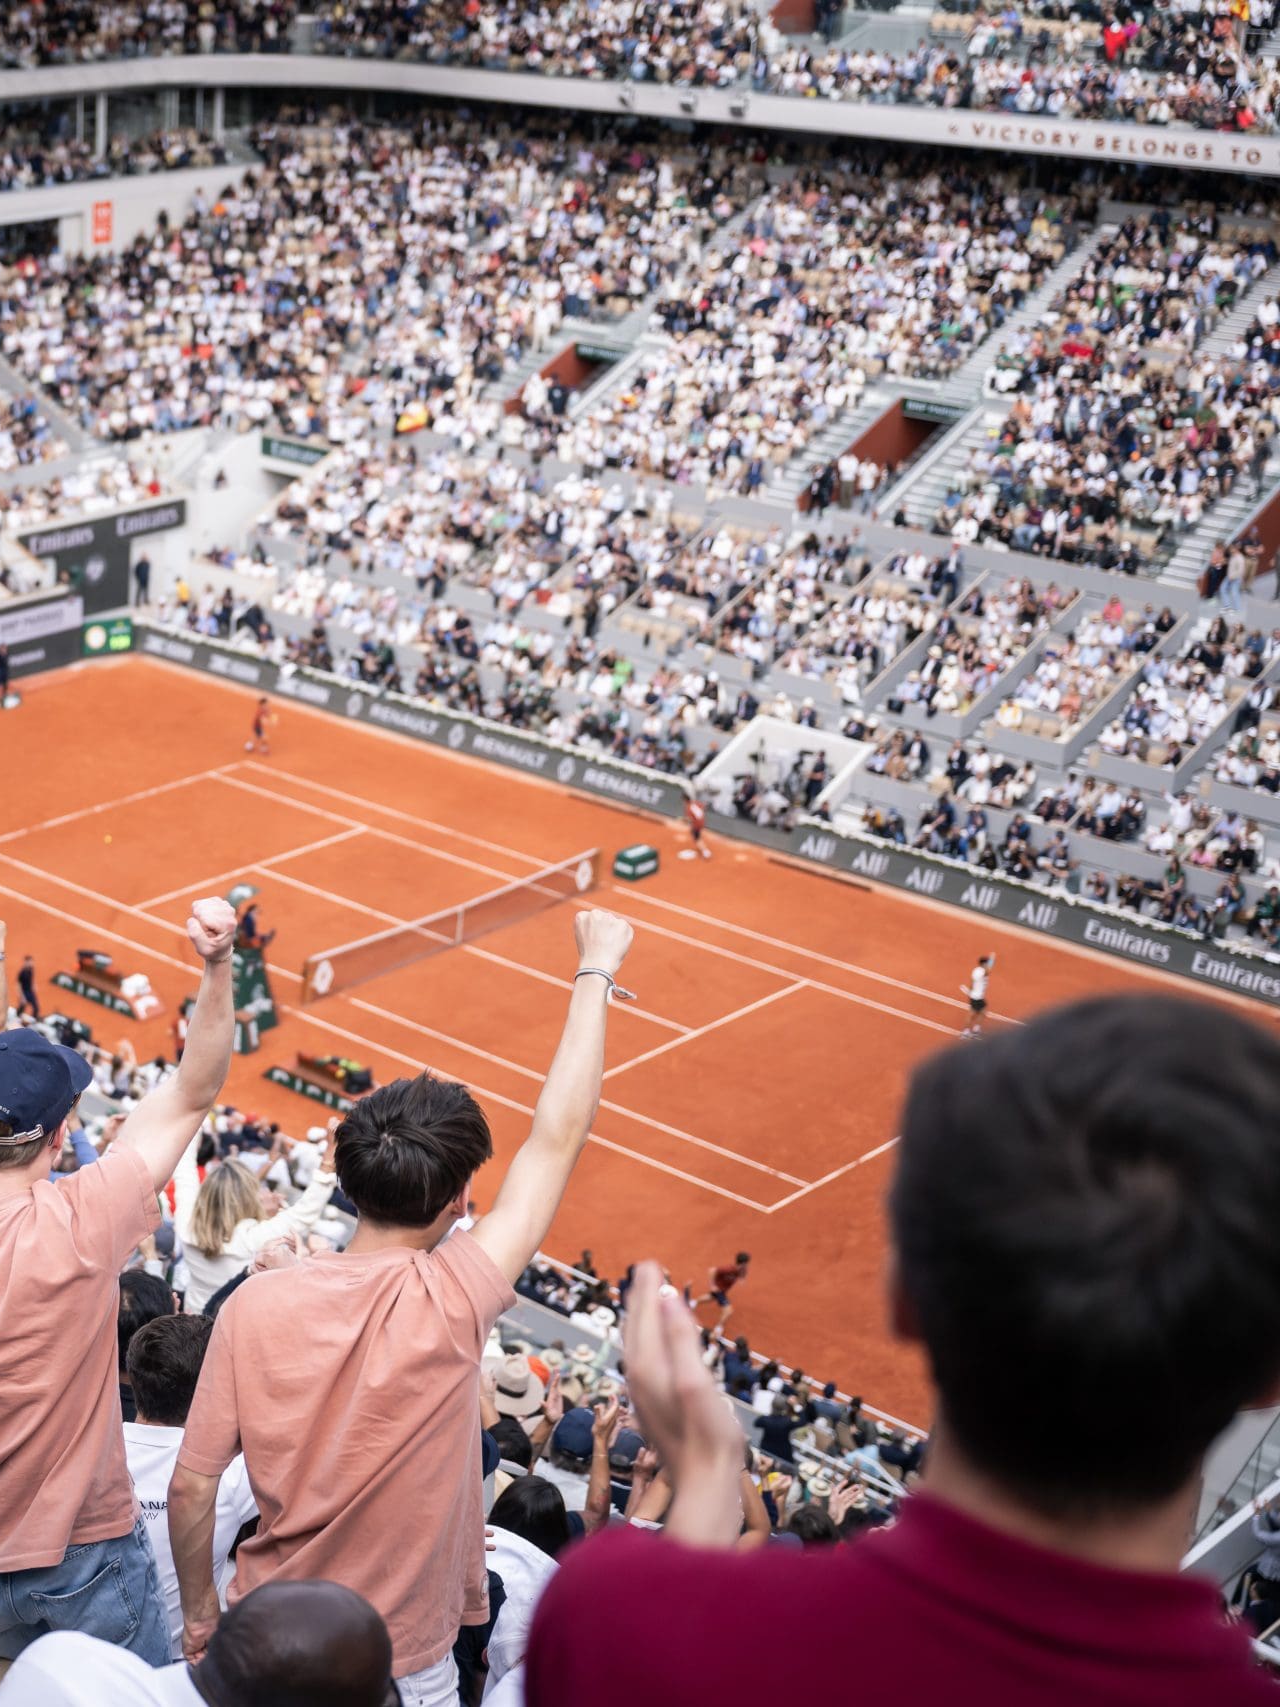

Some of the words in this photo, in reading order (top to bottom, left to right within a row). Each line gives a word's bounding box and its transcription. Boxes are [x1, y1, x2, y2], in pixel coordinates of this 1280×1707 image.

[972, 122, 1079, 149] VICTORY
[1094, 134, 1214, 161] BELONGS
[1231, 144, 1263, 165] TO
[473, 734, 548, 769] RENAULT
[583, 768, 665, 806] RENAULT
[1083, 918, 1171, 963] Emirates
[1191, 950, 1280, 998] Emirates
